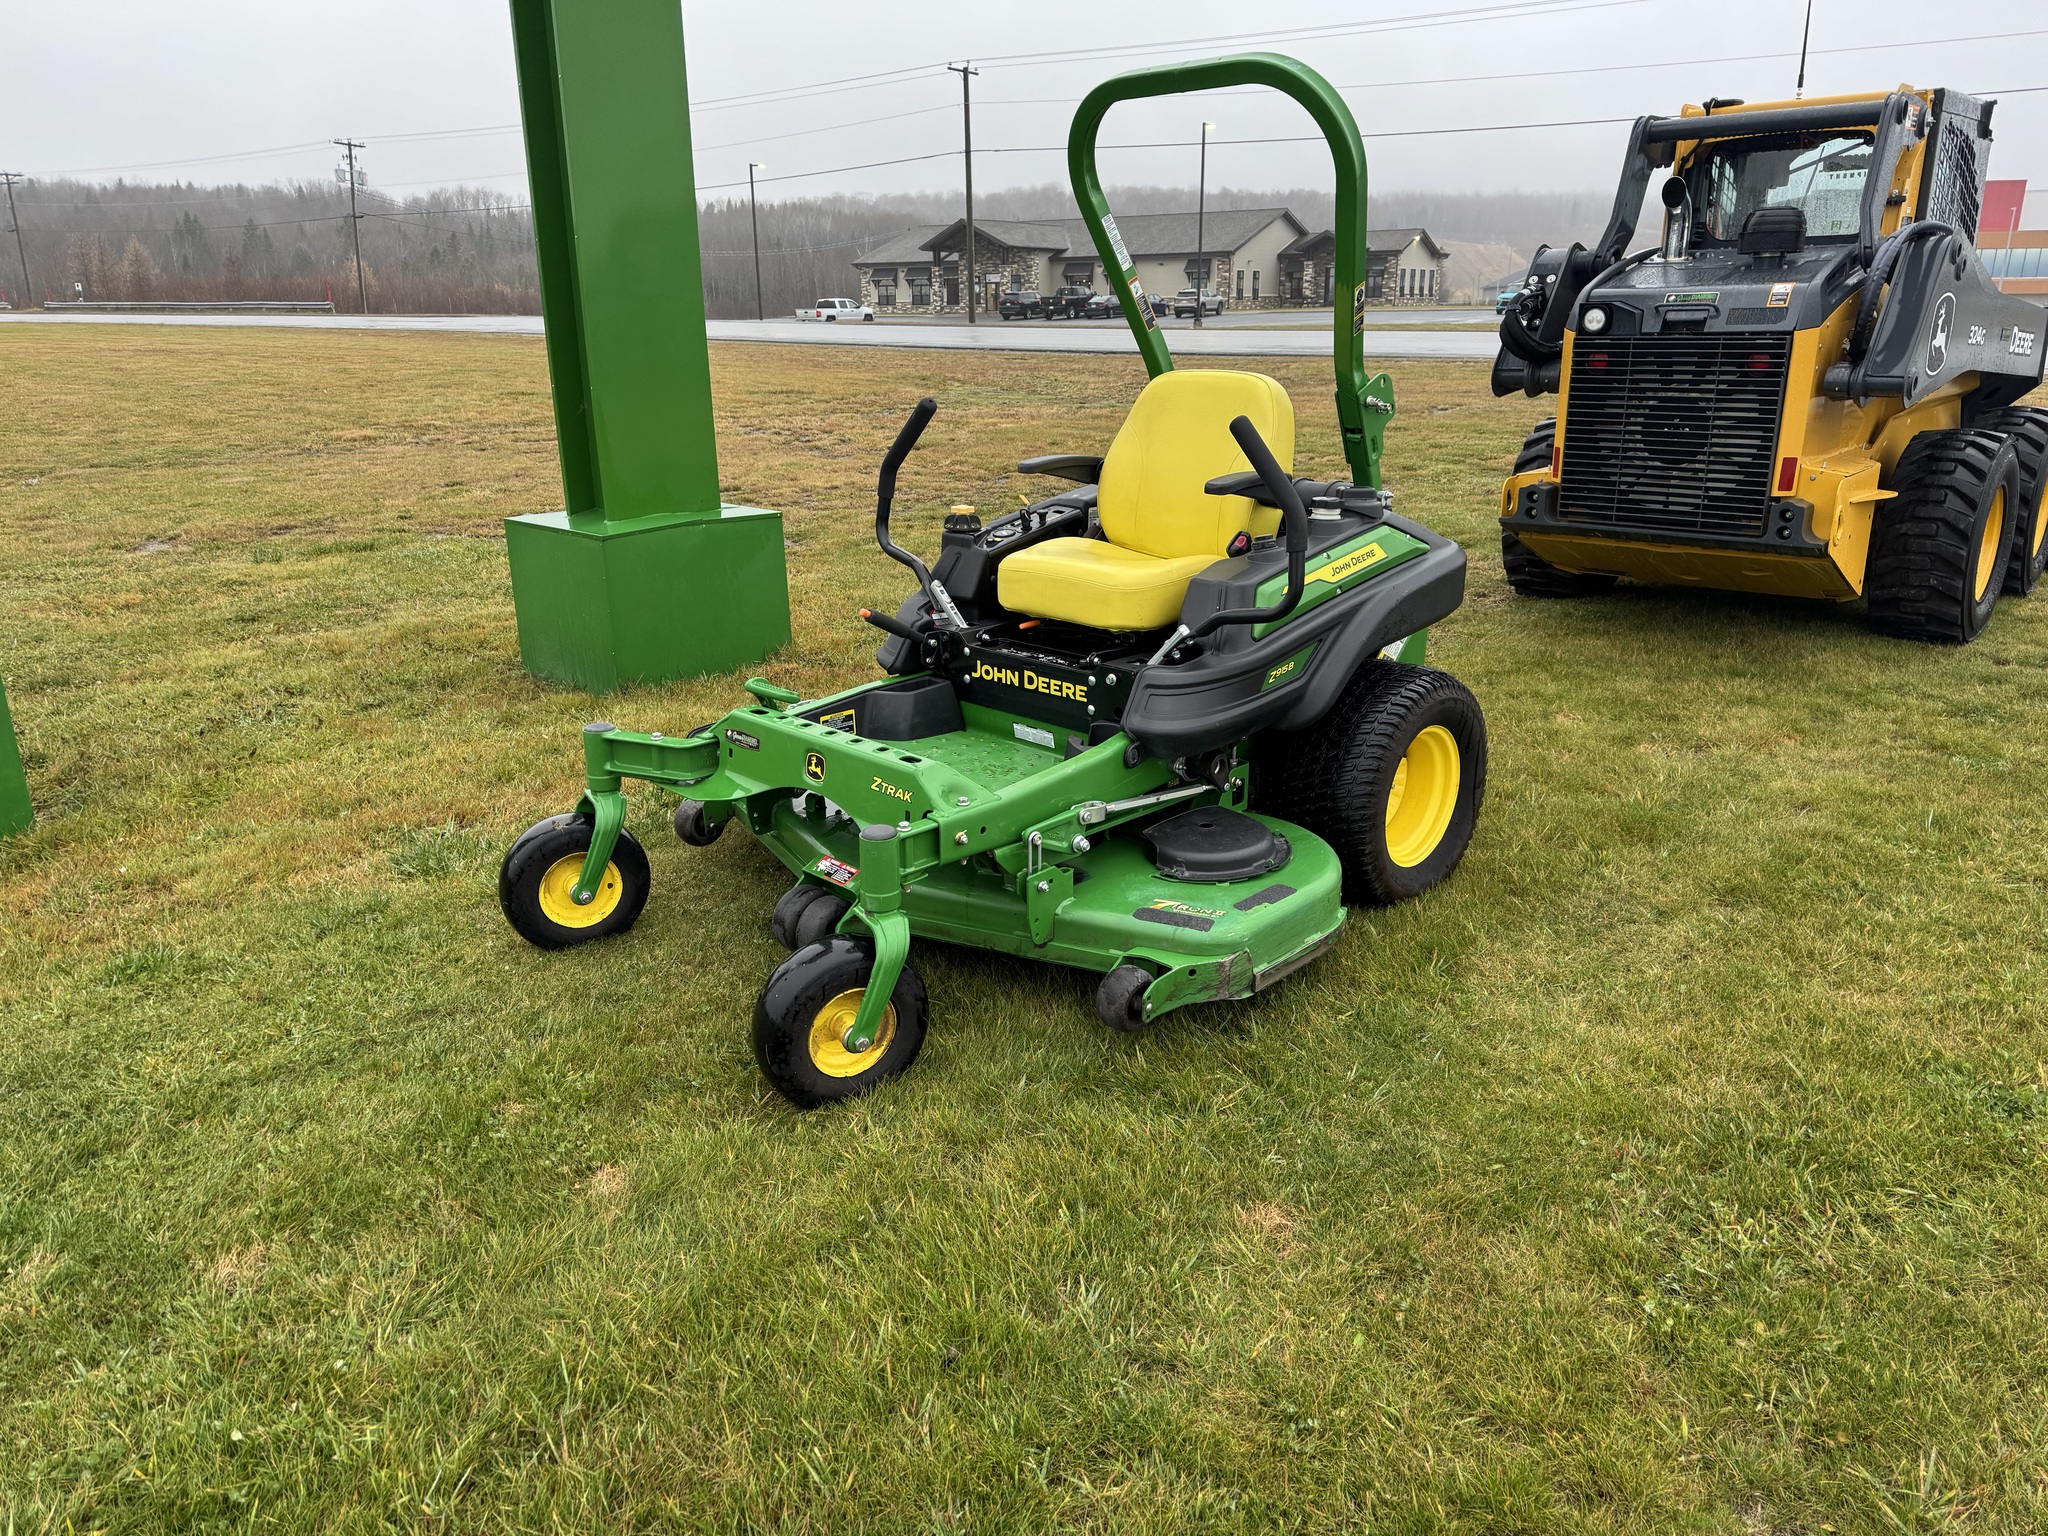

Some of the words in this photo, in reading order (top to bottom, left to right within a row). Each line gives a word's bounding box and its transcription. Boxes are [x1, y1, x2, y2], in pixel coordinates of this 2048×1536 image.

[1967, 325, 1987, 346] 324G
[2009, 325, 2035, 355] DEERE
[1331, 561, 1352, 577] JOHN
[1351, 549, 1377, 567] DEERE
[971, 660, 1019, 687] JOHN
[1023, 670, 1088, 702] DEERE
[870, 775, 914, 804] ZTRAK
